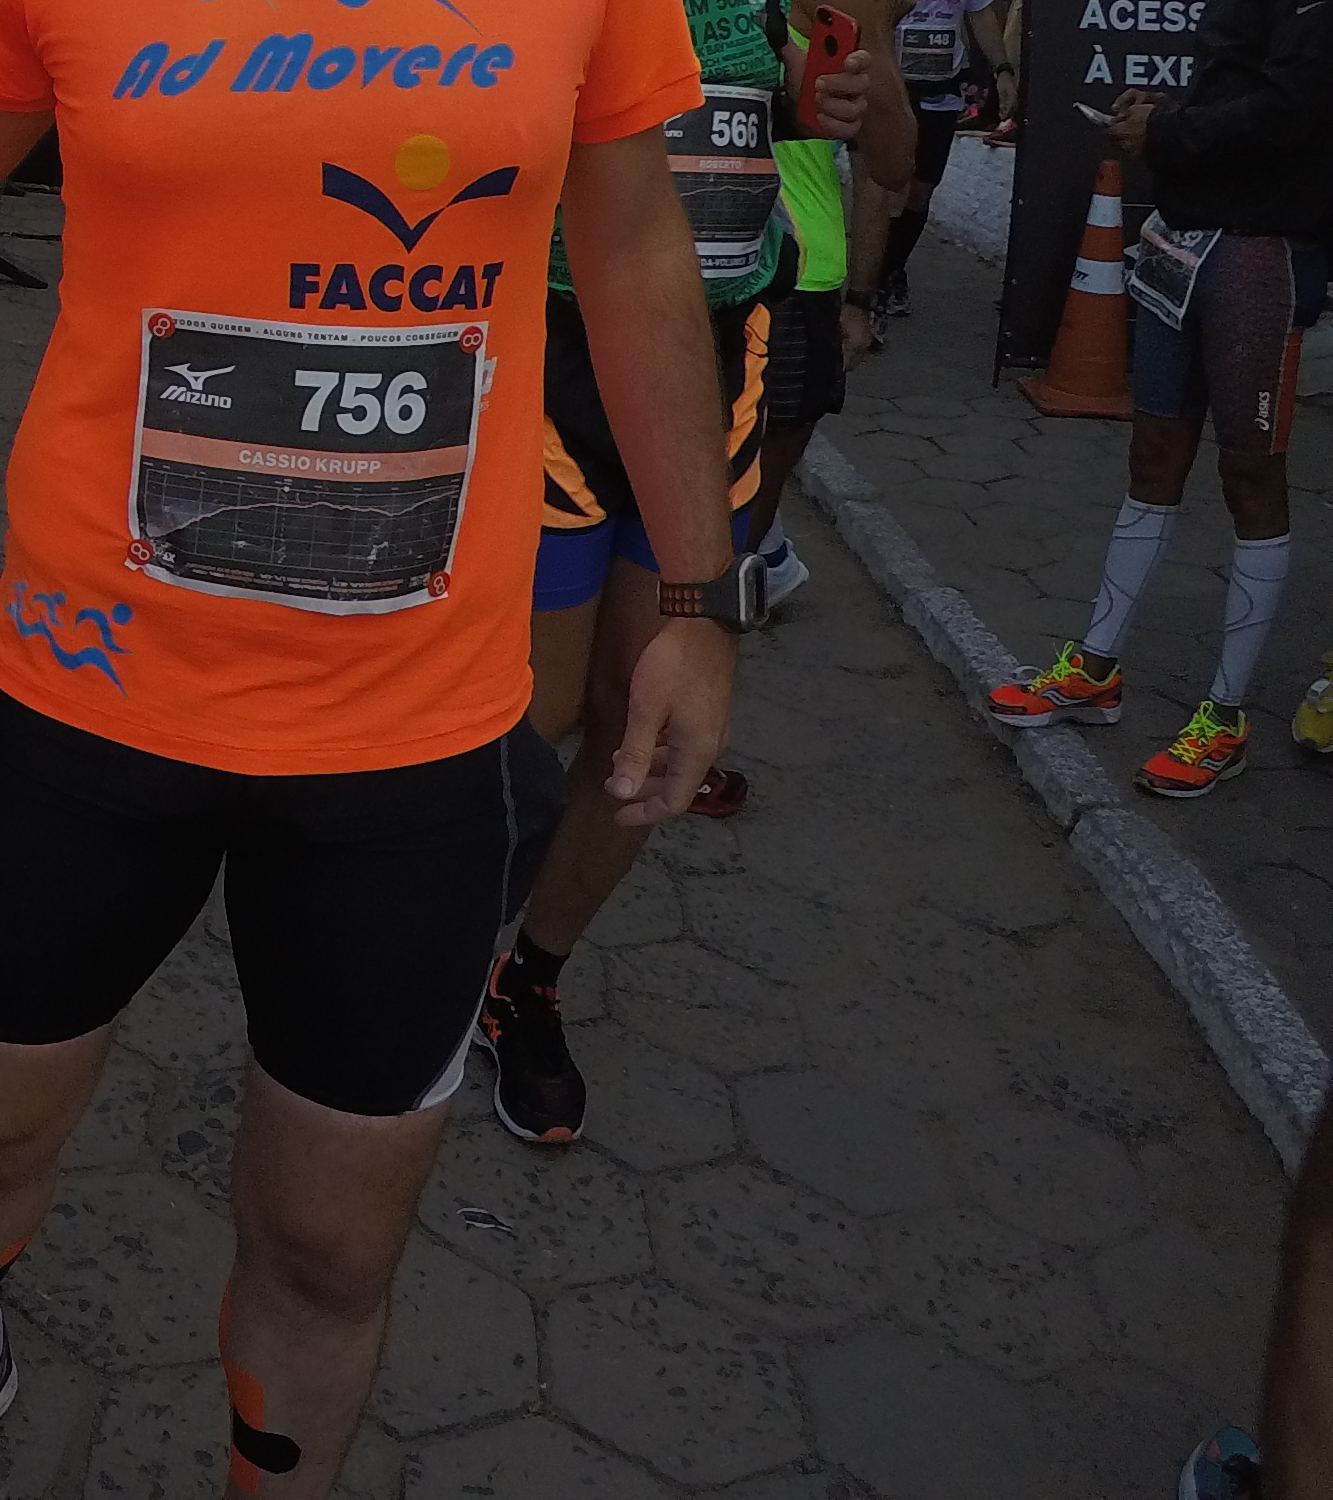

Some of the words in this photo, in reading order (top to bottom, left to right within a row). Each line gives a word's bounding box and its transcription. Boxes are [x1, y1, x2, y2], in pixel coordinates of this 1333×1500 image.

[703, 16, 731, 44] AS
[1079, 0, 1206, 32] ACESS
[113, 37, 226, 100] Ad
[231, 32, 515, 93] Movere
[1083, 44, 1113, 85] À
[1125, 55, 1194, 87] EXP
[710, 110, 759, 149] 566
[288, 260, 504, 313] FACCAT
[172, 318, 207, 329] TODOS
[210, 321, 252, 333] QUEREM
[263, 328, 303, 339] ALGUNS
[307, 332, 349, 342] TENTAM
[360, 334, 402, 343] POUCOS
[159, 385, 232, 410] MIZUNO
[294, 369, 428, 435] 756
[238, 449, 311, 472] CASSIO
[315, 456, 382, 475] KRUPP
